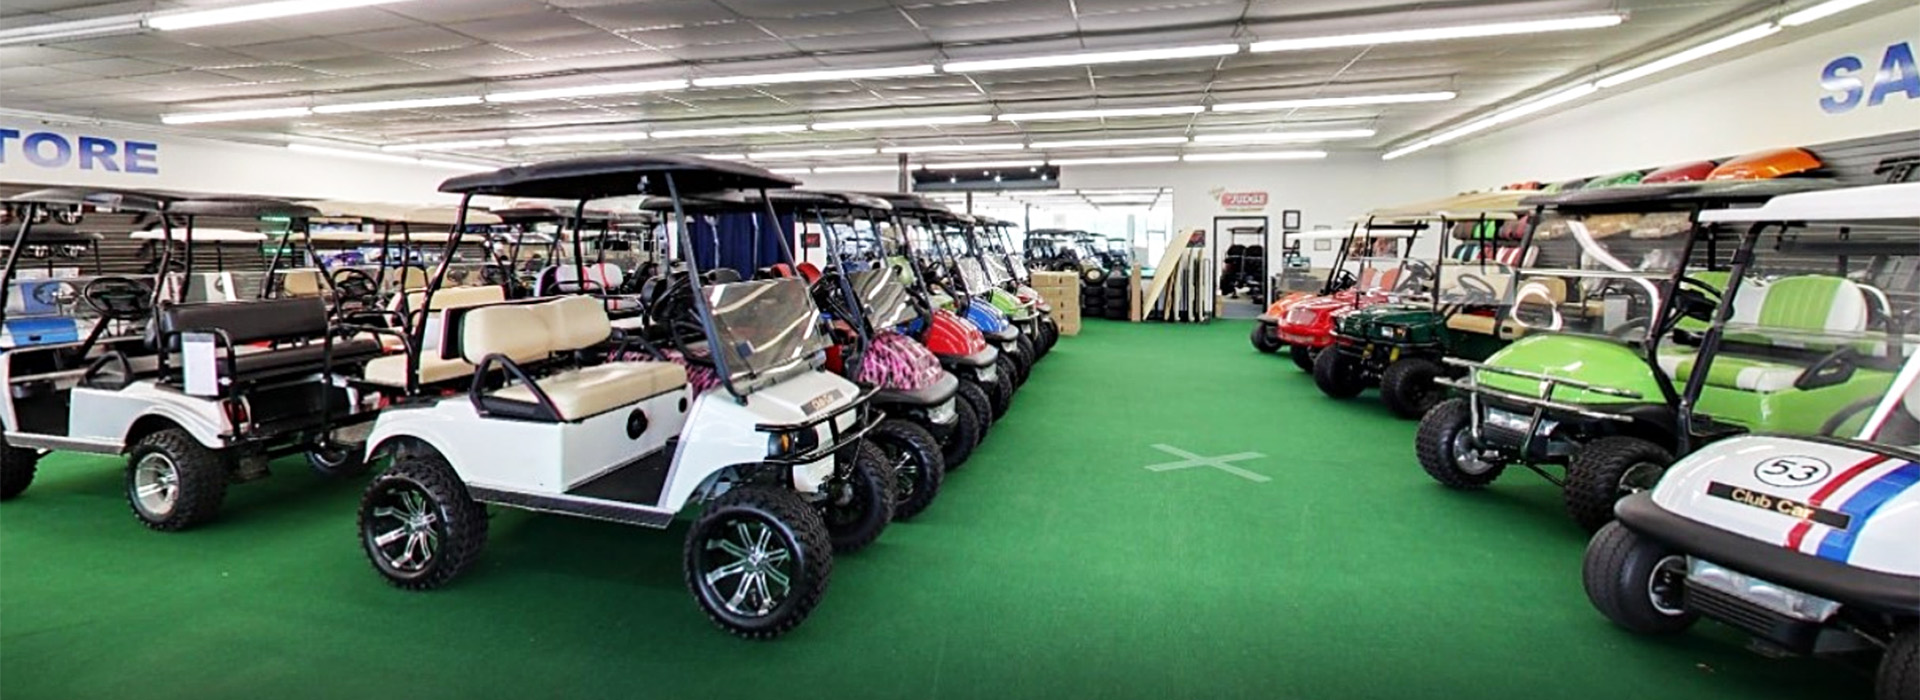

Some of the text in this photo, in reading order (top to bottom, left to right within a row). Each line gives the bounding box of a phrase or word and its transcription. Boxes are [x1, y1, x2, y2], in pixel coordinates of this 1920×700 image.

[1820, 42, 1920, 114] SA
[1763, 459, 1819, 481] 53
[1731, 488, 1815, 519] Club Car
